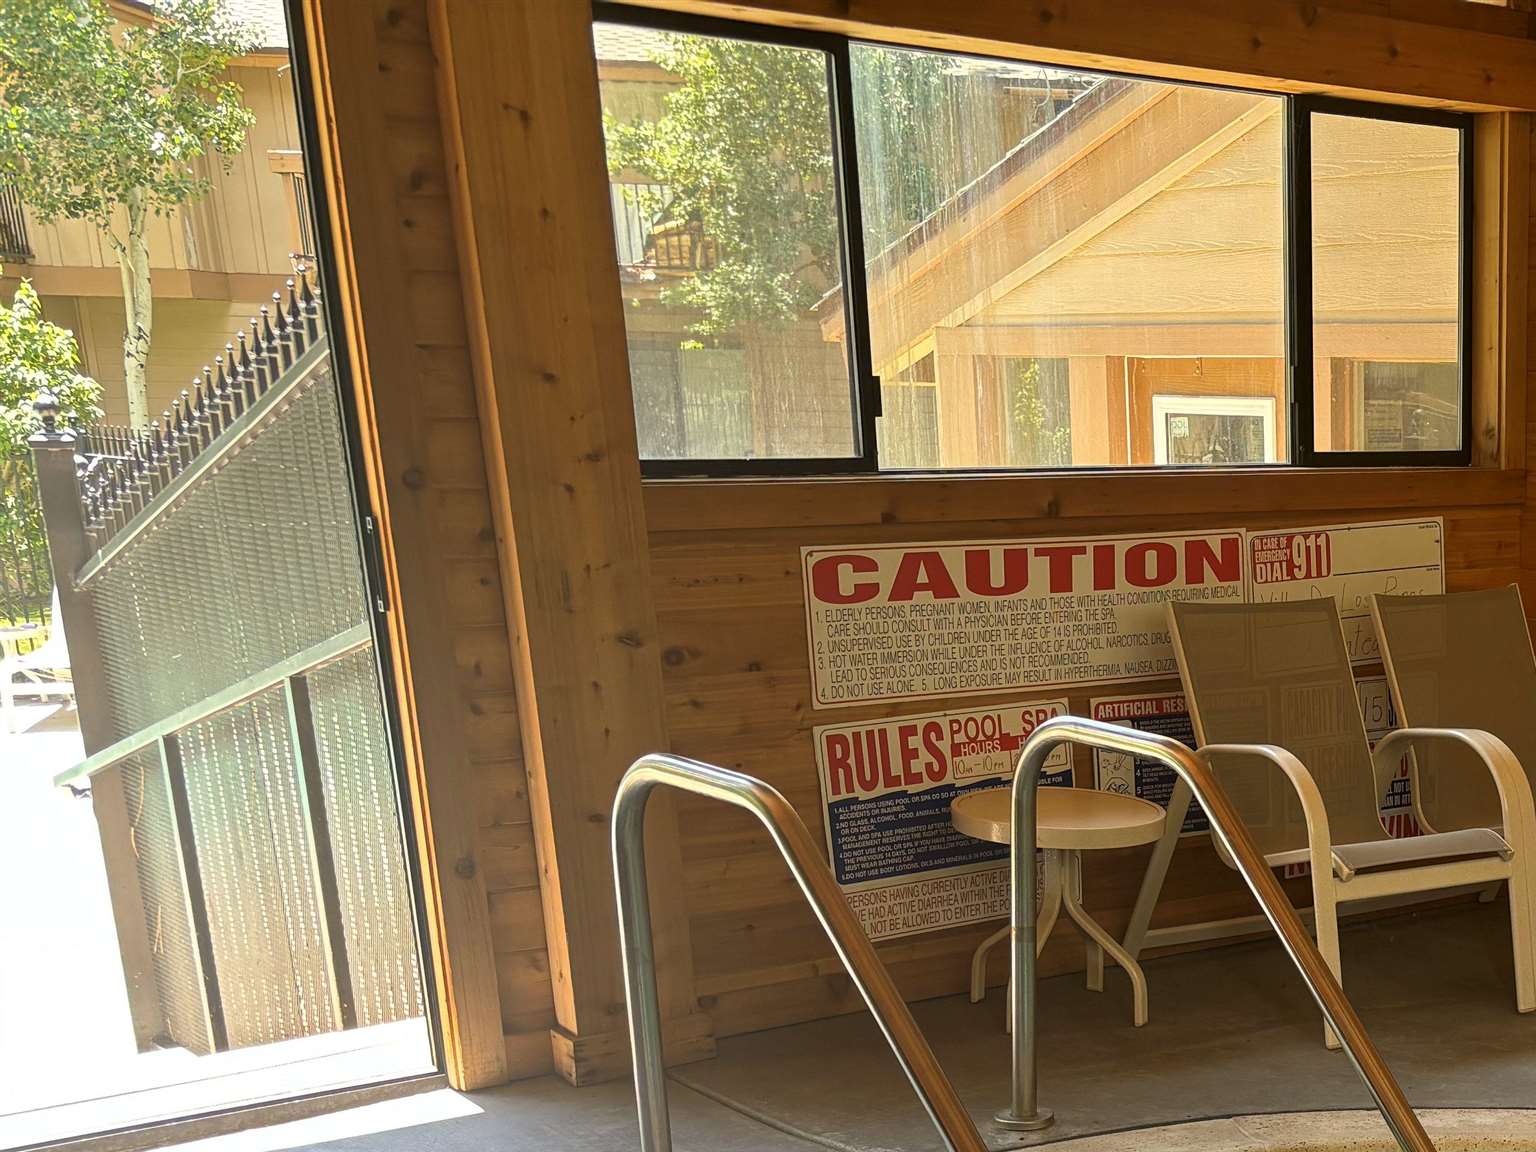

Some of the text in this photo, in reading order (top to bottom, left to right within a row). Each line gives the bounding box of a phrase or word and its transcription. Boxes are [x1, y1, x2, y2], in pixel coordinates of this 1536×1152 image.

[1254, 535, 1288, 551] IN CASE OF
[1255, 550, 1290, 564] EMERGENCY
[1292, 533, 1329, 580] 911
[812, 537, 1241, 605] CAUTION
[1256, 562, 1291, 584] DIAL
[826, 608, 862, 622] ELDERLY
[910, 603, 955, 617] PREGNANT
[994, 598, 1028, 612] INFANTS
[1030, 597, 1047, 610] AND
[1050, 595, 1075, 608] THOSE
[1077, 594, 1095, 607] WITH
[1099, 592, 1125, 606] HEALTH
[1127, 589, 1170, 604] CONDITIONS
[1211, 585, 1240, 599] MEDICAL
[817, 622, 1119, 654] 2. UNSUPERVISED USE BY CHILDREN UNDER THE AGE OF 14 IS PROHIBITED.
[827, 624, 850, 638] CARE
[853, 622, 889, 636] SHOULD
[892, 619, 932, 634] CONSULT
[933, 618, 954, 631] WITH
[957, 617, 962, 630] A
[965, 614, 1008, 629] PHYSICIAN
[1011, 612, 1042, 626] BEFORE
[1044, 610, 1082, 624] ENTERING
[1085, 609, 1099, 621] THE
[818, 657, 826, 669] 3.
[829, 655, 847, 669] HOT
[849, 653, 877, 667] WATER
[880, 649, 929, 665] IMMERSION
[931, 647, 956, 661] WHILE
[959, 645, 987, 659] UNDER
[990, 644, 1005, 657] THE
[1008, 640, 1053, 655] INFLUENCE
[1054, 640, 1064, 652] OF
[1151, 632, 1171, 645] DRUG
[821, 687, 828, 699] 4.
[831, 685, 844, 698] DO
[847, 684, 864, 697] NOT
[867, 682, 884, 695] USE
[933, 677, 957, 690] LONG
[960, 673, 1000, 688] EXPOSURE
[1005, 671, 1021, 684] MAY
[1023, 669, 1052, 683] RESULT
[1055, 668, 1062, 680] IN
[831, 670, 853, 683] LEAD
[856, 669, 867, 681] TO
[870, 666, 906, 680] SERIOUS
[909, 660, 978, 677] CONSEQUENCES
[980, 659, 997, 672] AND
[999, 658, 1007, 670] IS
[1010, 657, 1025, 670] NOT
[1098, 701, 1159, 719] ARTIFICIAL
[949, 714, 1010, 743] POOL
[825, 720, 949, 796] RULES
[960, 738, 1000, 757] HOURS
[868, 905, 885, 920] HAD
[887, 900, 916, 917] ACTIVE
[918, 893, 959, 912] DIARRHEA
[960, 888, 988, 905] WITHIN
[989, 886, 1004, 900] THE
[890, 886, 919, 903] HAVING
[921, 879, 968, 898] CURRENTLY
[969, 874, 998, 890] ACTIVE
[870, 920, 888, 935] NOT
[889, 918, 901, 931] BE
[902, 911, 941, 929] ALLOWED
[942, 909, 952, 922] TO
[954, 904, 981, 920] ENTER
[983, 901, 998, 915] THE
